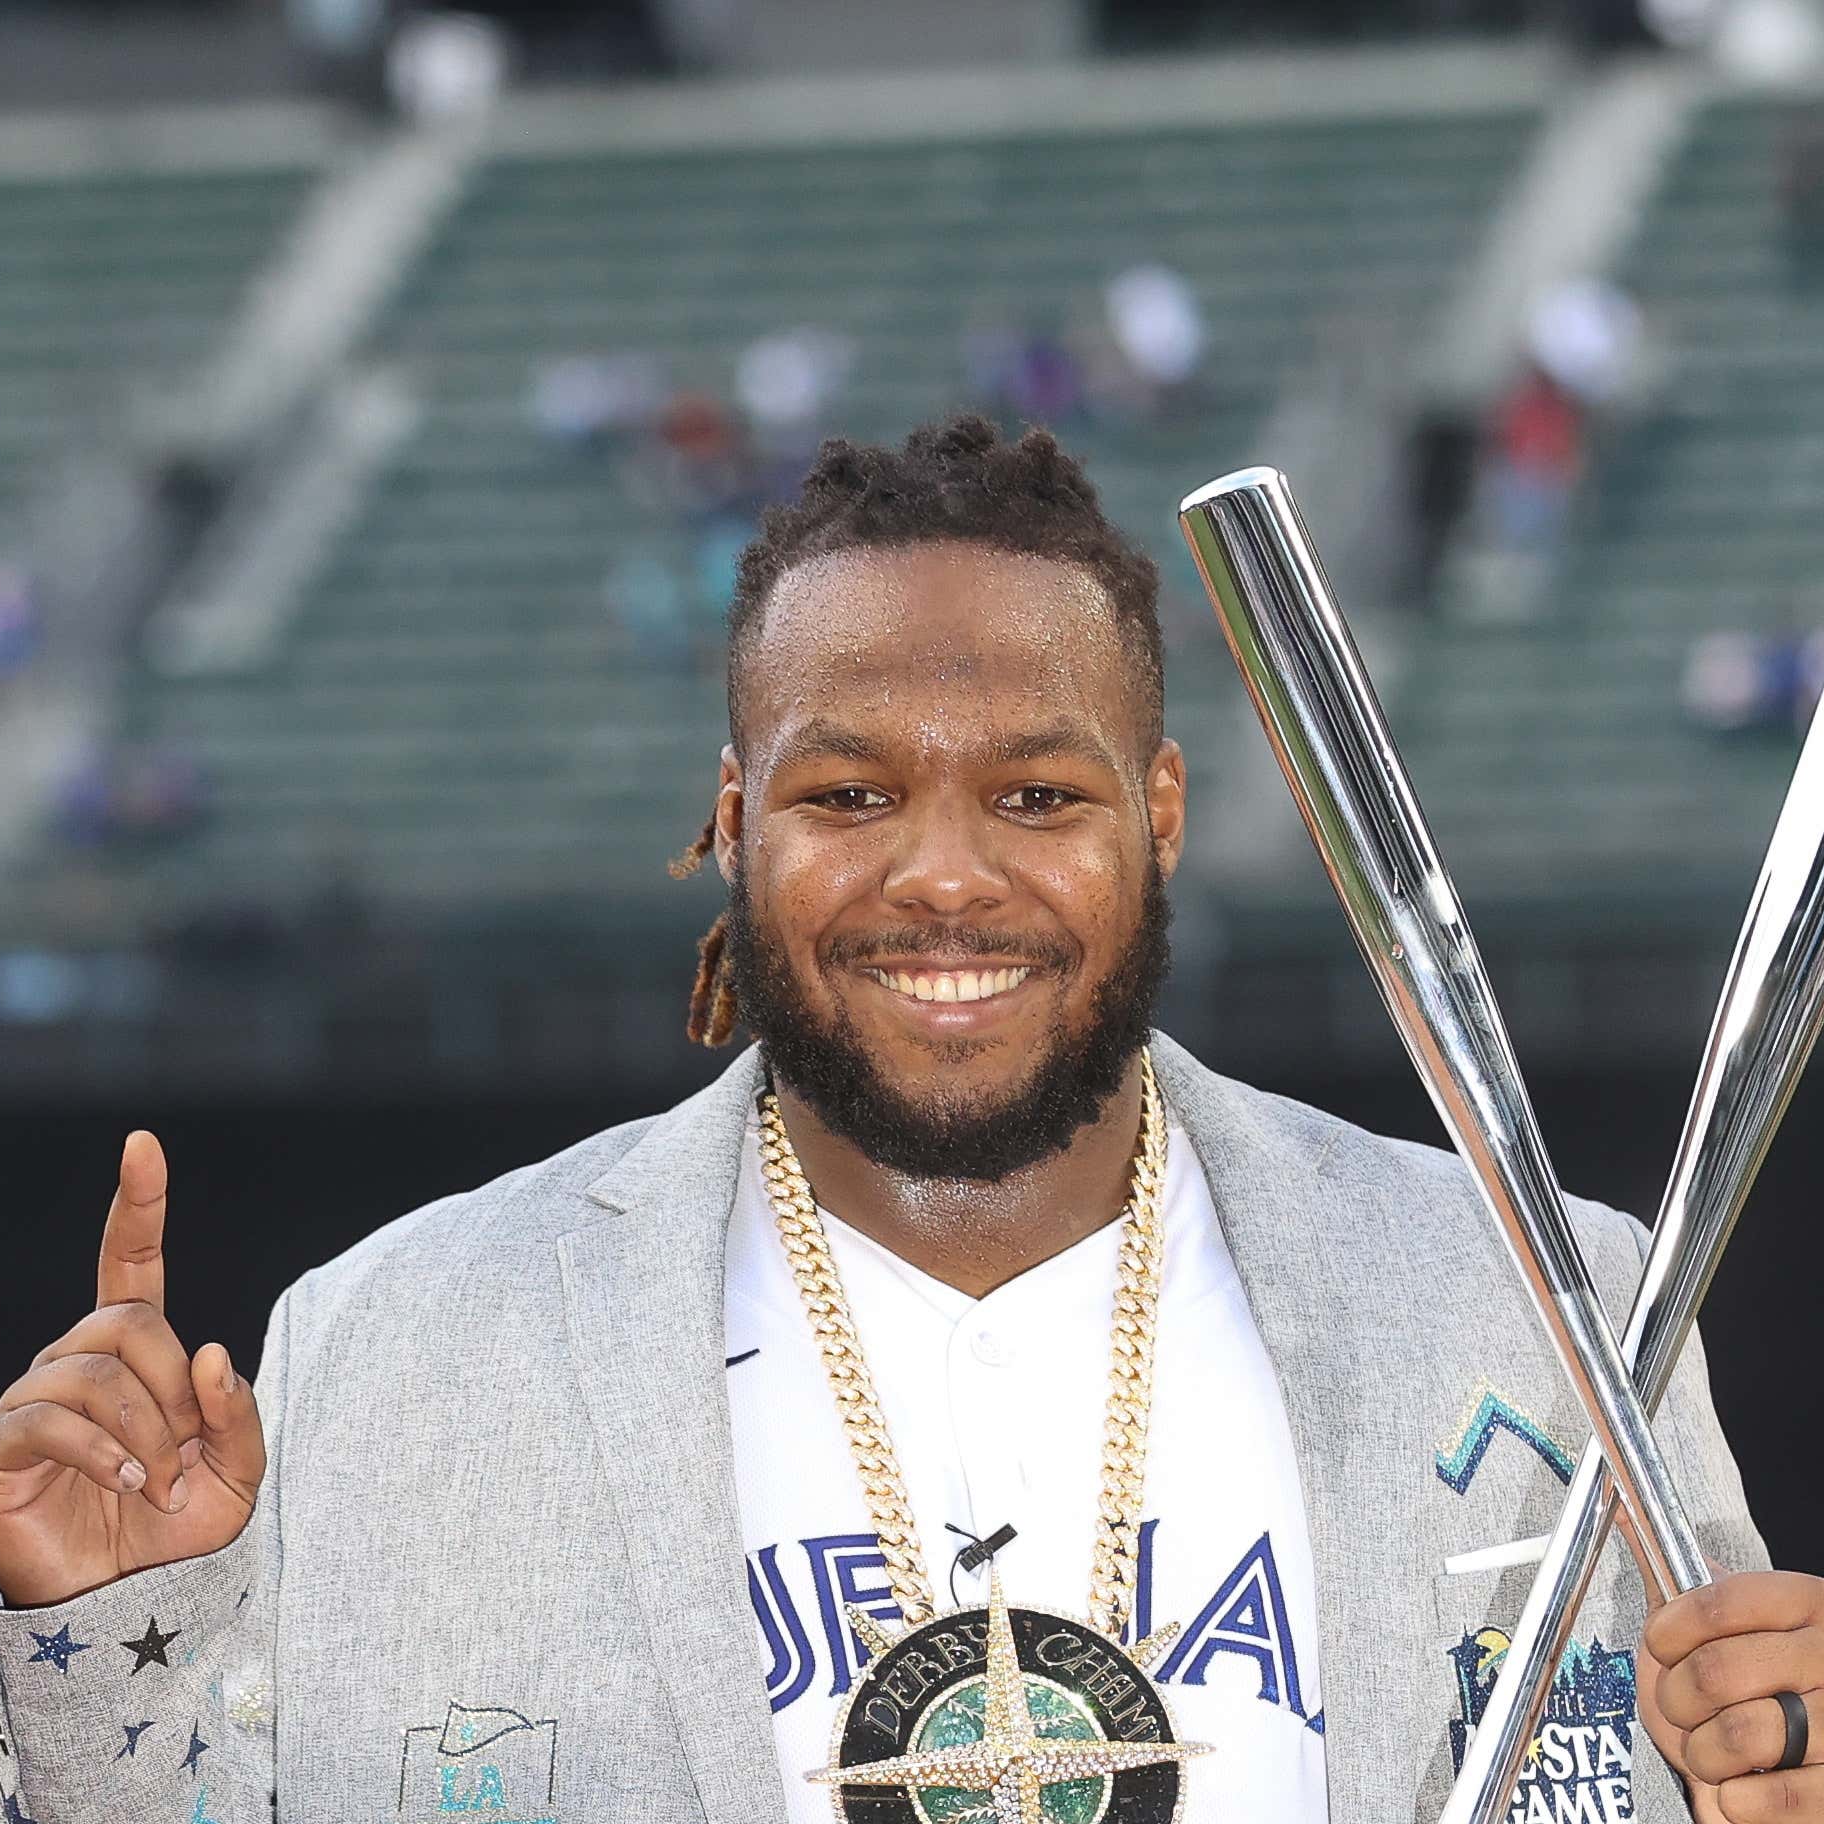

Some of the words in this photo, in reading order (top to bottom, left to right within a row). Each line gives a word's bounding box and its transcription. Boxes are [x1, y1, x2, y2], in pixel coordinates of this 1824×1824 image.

[1034, 1632, 1162, 1742] CHAM
[1540, 1720, 1637, 1781] STA
[437, 1764, 507, 1813] LA
